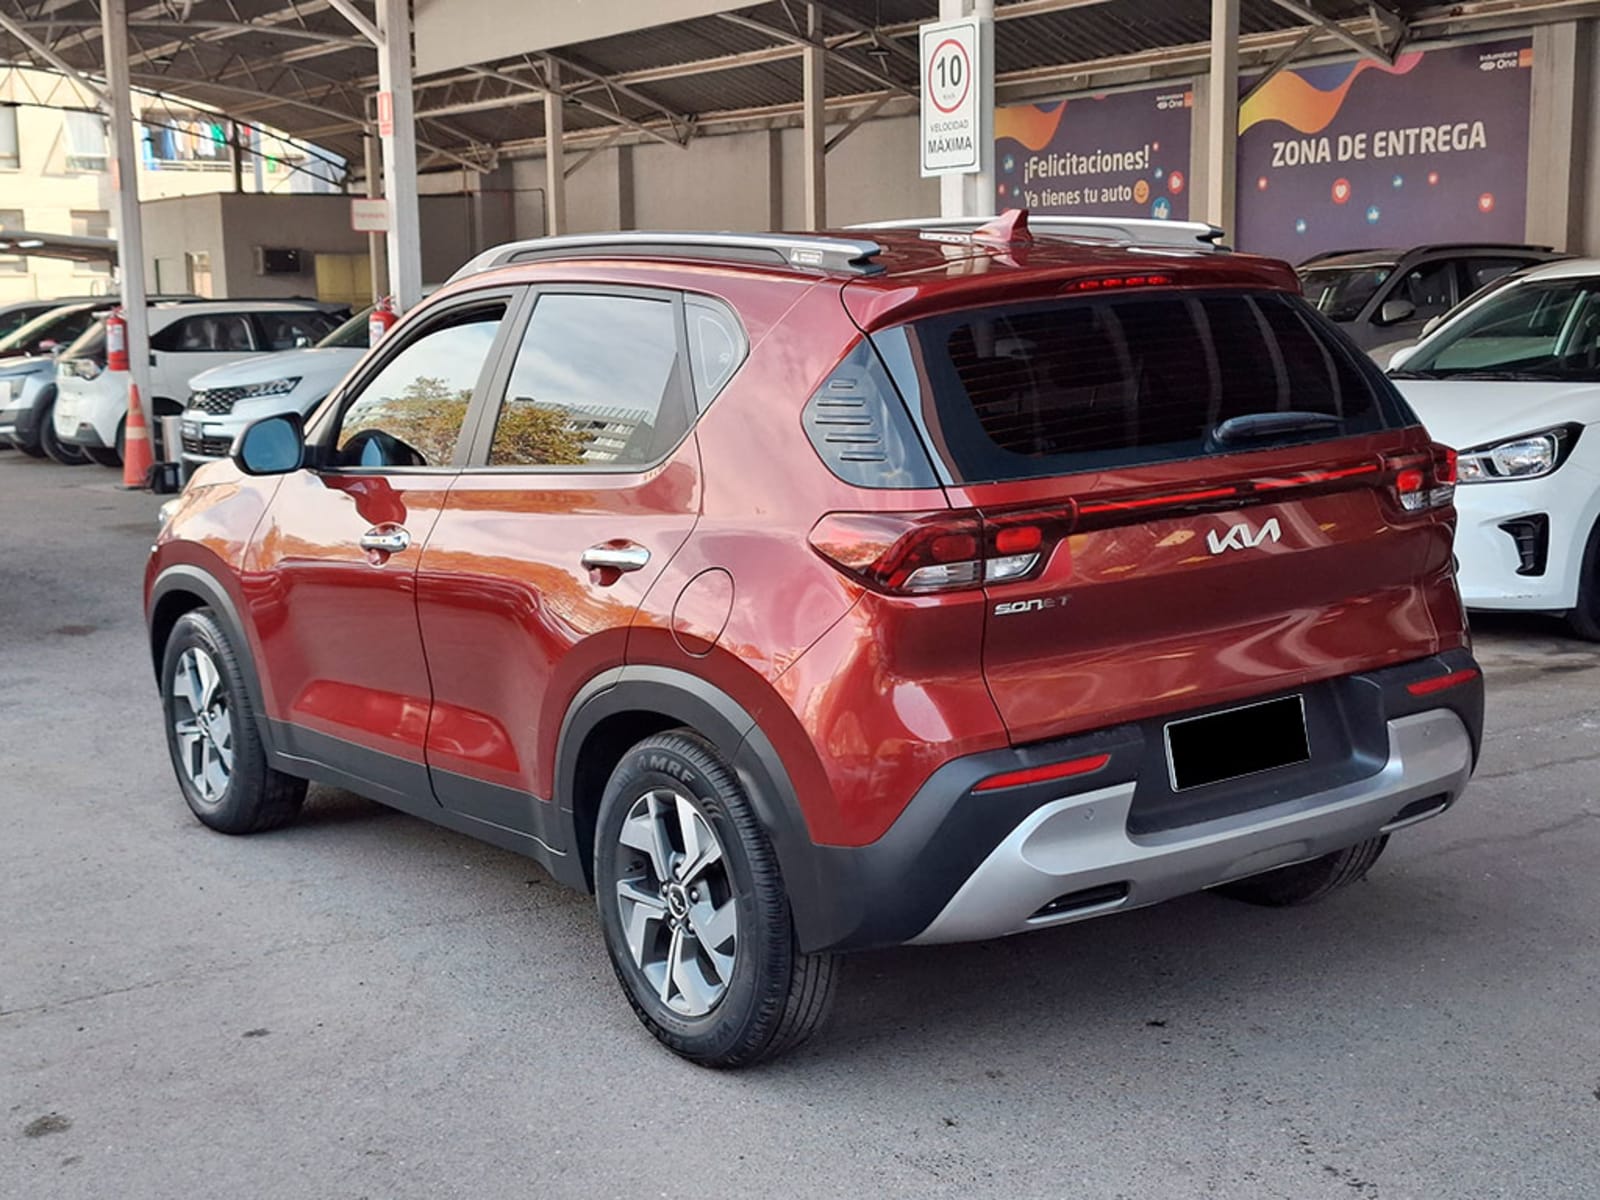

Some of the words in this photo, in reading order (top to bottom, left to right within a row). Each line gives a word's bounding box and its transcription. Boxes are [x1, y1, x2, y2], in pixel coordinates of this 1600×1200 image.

[936, 55, 962, 88] 10
[1497, 59, 1518, 70] One
[930, 120, 969, 133] VELOCIDAD
[1272, 137, 1331, 168] ZONA
[1338, 133, 1367, 160] DE
[1373, 121, 1487, 158] ENTREGA
[1024, 144, 1150, 184] ¡Felicitaciones!
[1024, 190, 1039, 207] Ya
[1042, 188, 1082, 207] tienes
[1084, 186, 1097, 204] tu
[1101, 184, 1132, 202] auto
[1207, 517, 1282, 554] KIA
[650, 755, 695, 781] MRF
